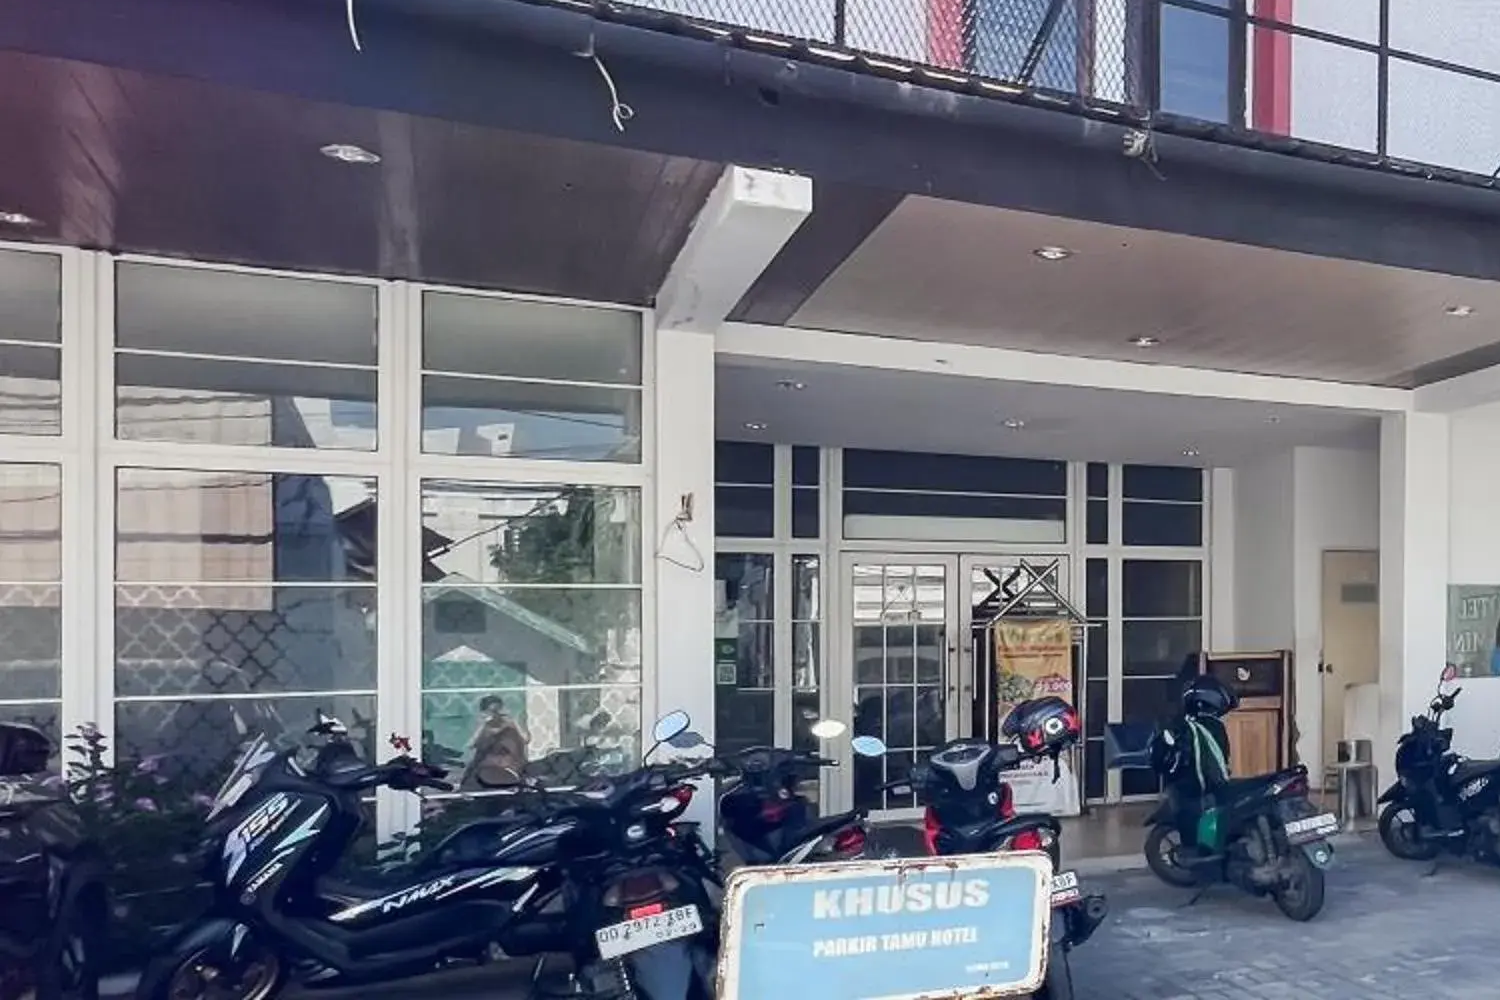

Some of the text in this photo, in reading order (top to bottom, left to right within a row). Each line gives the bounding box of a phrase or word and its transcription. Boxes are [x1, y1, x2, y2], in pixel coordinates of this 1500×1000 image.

[813, 878, 990, 919] KHUSUS
[813, 935, 876, 958] PARKIR
[881, 931, 927, 952] TAMU
